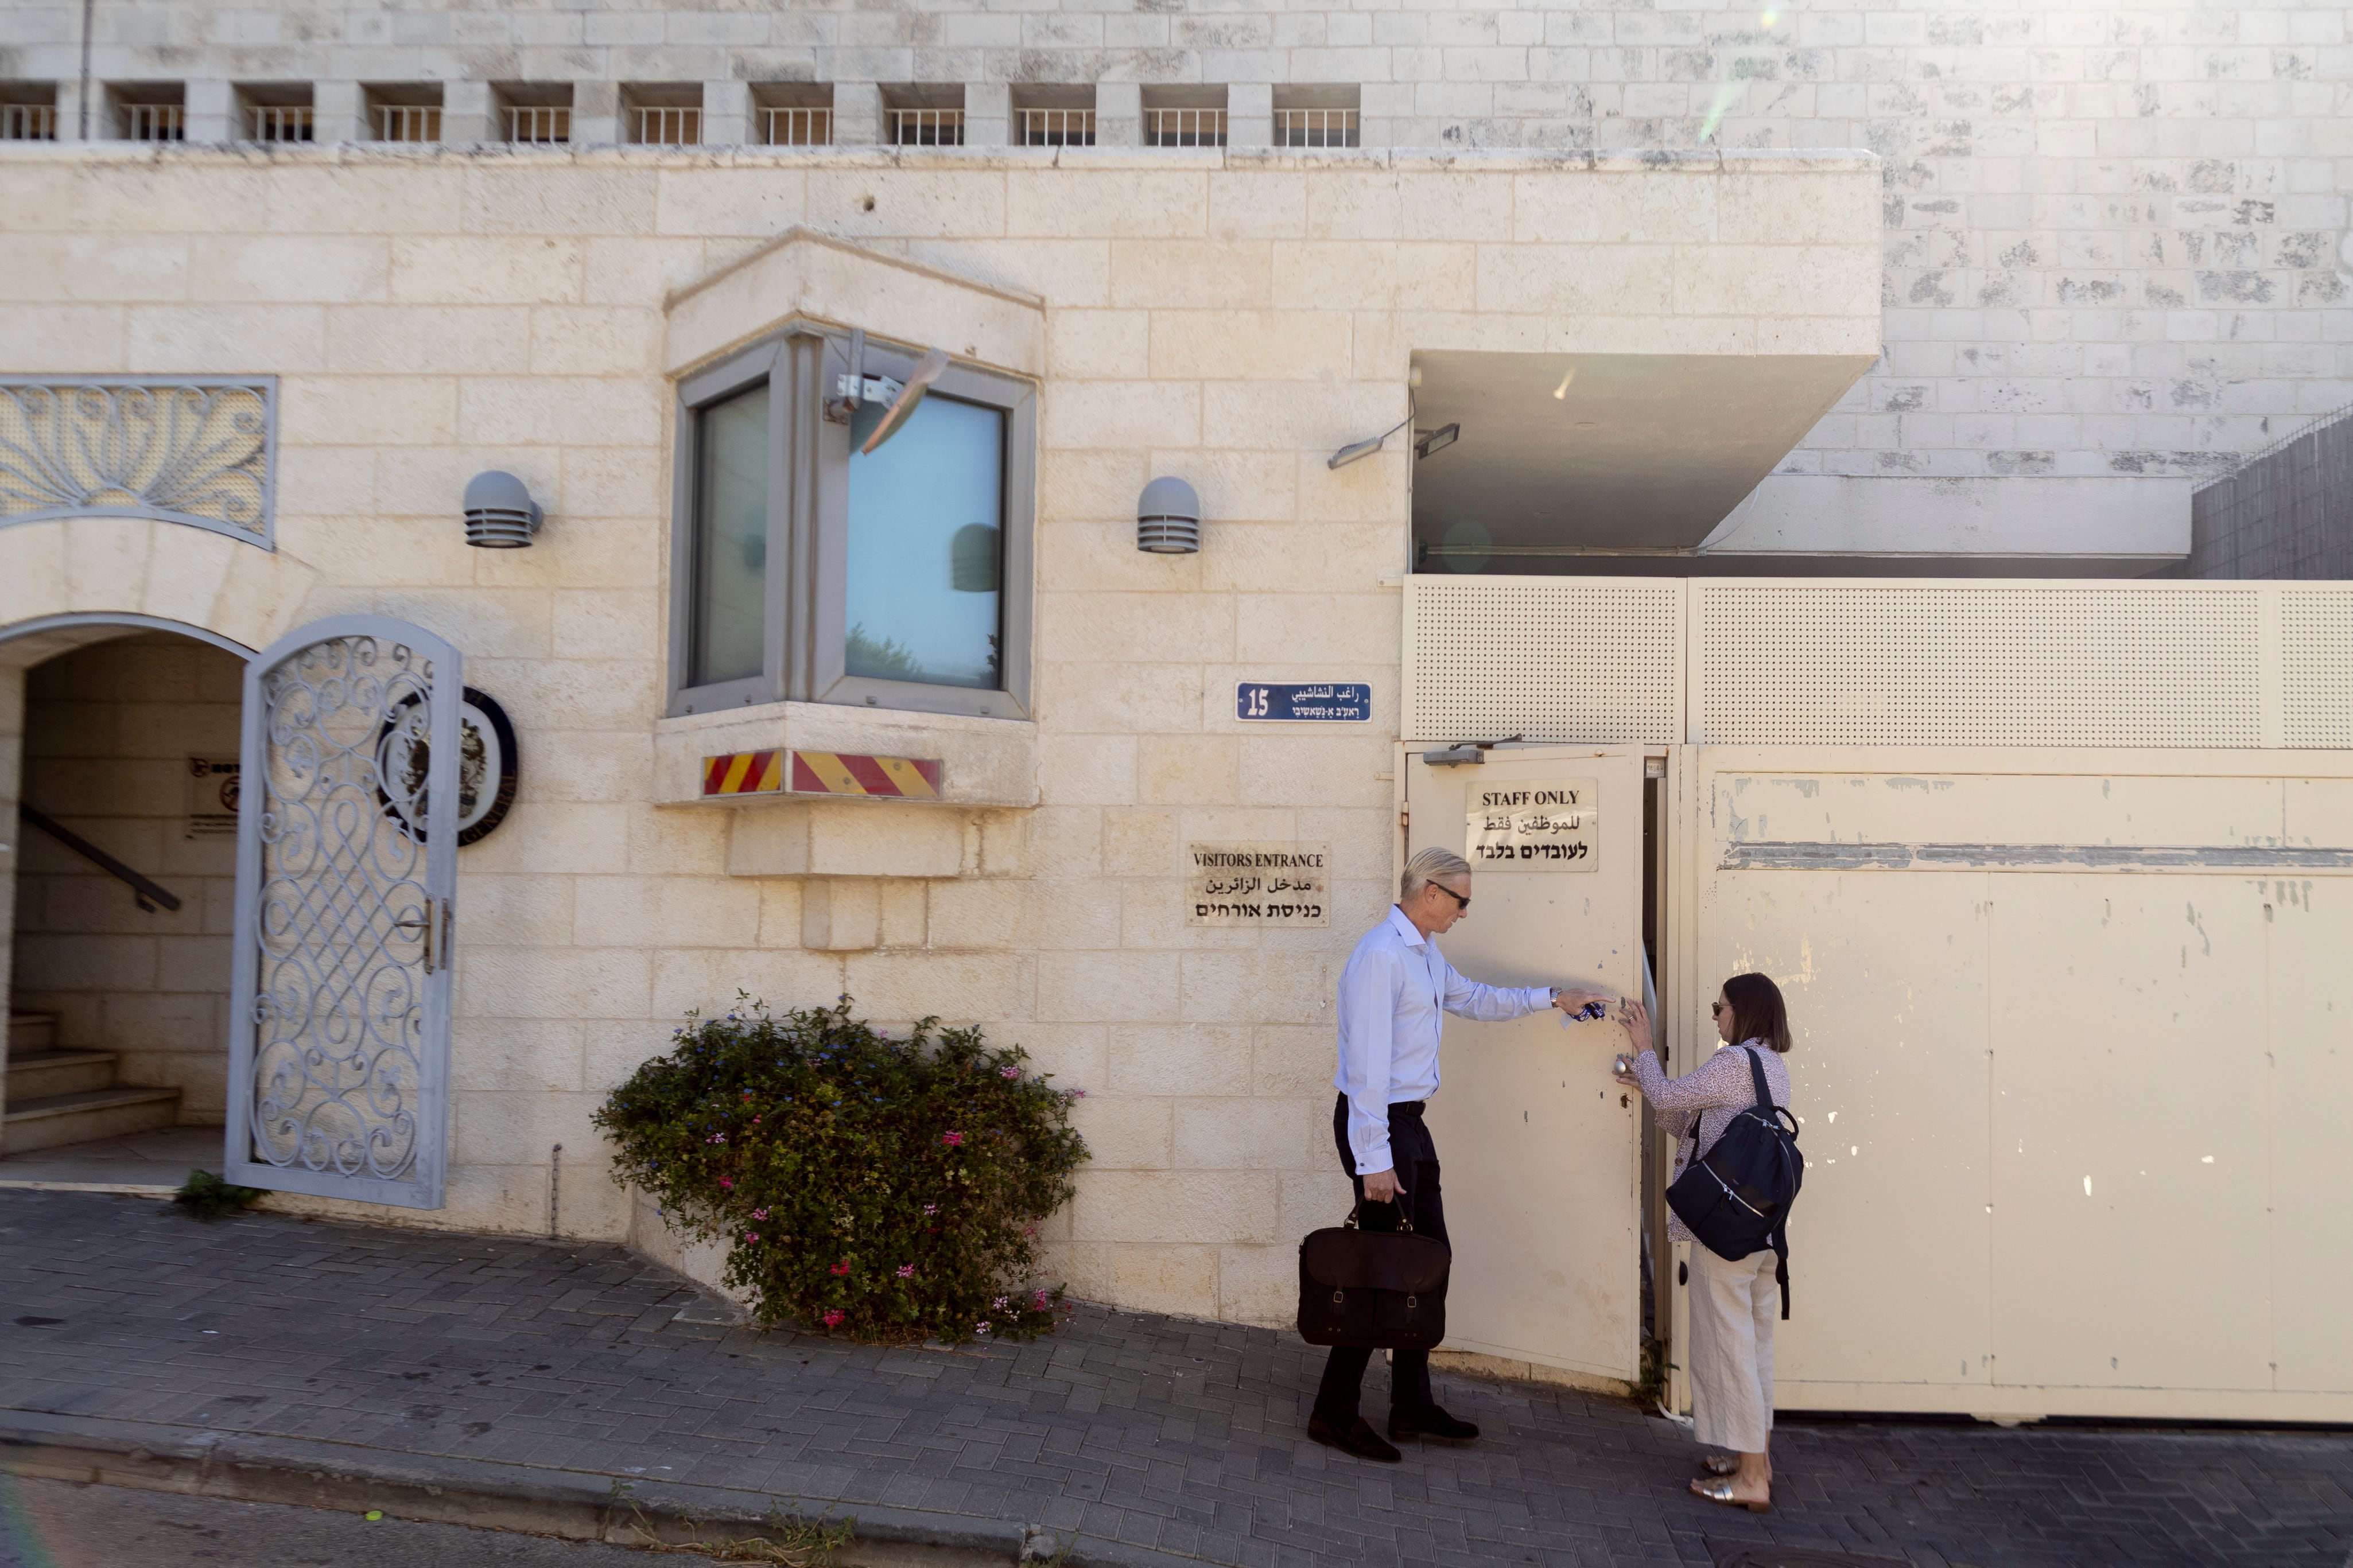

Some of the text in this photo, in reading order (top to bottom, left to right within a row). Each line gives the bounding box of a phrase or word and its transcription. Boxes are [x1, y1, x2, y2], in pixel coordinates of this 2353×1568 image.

[1247, 688, 1269, 716] 15
[1292, 685, 1360, 703] راغب النشاشيبي
[462, 770, 517, 843] GENERAL
[1482, 790, 1579, 806] STAFF ONLY
[1483, 815, 1580, 835] للموظفين فقط
[1476, 841, 1588, 860] לעובדים בלבד
[1194, 853, 1323, 867] VISITORS ENTRANCE
[1206, 877, 1311, 894] مدخل الزائرين
[1195, 903, 1321, 917] כניסת אורחים
